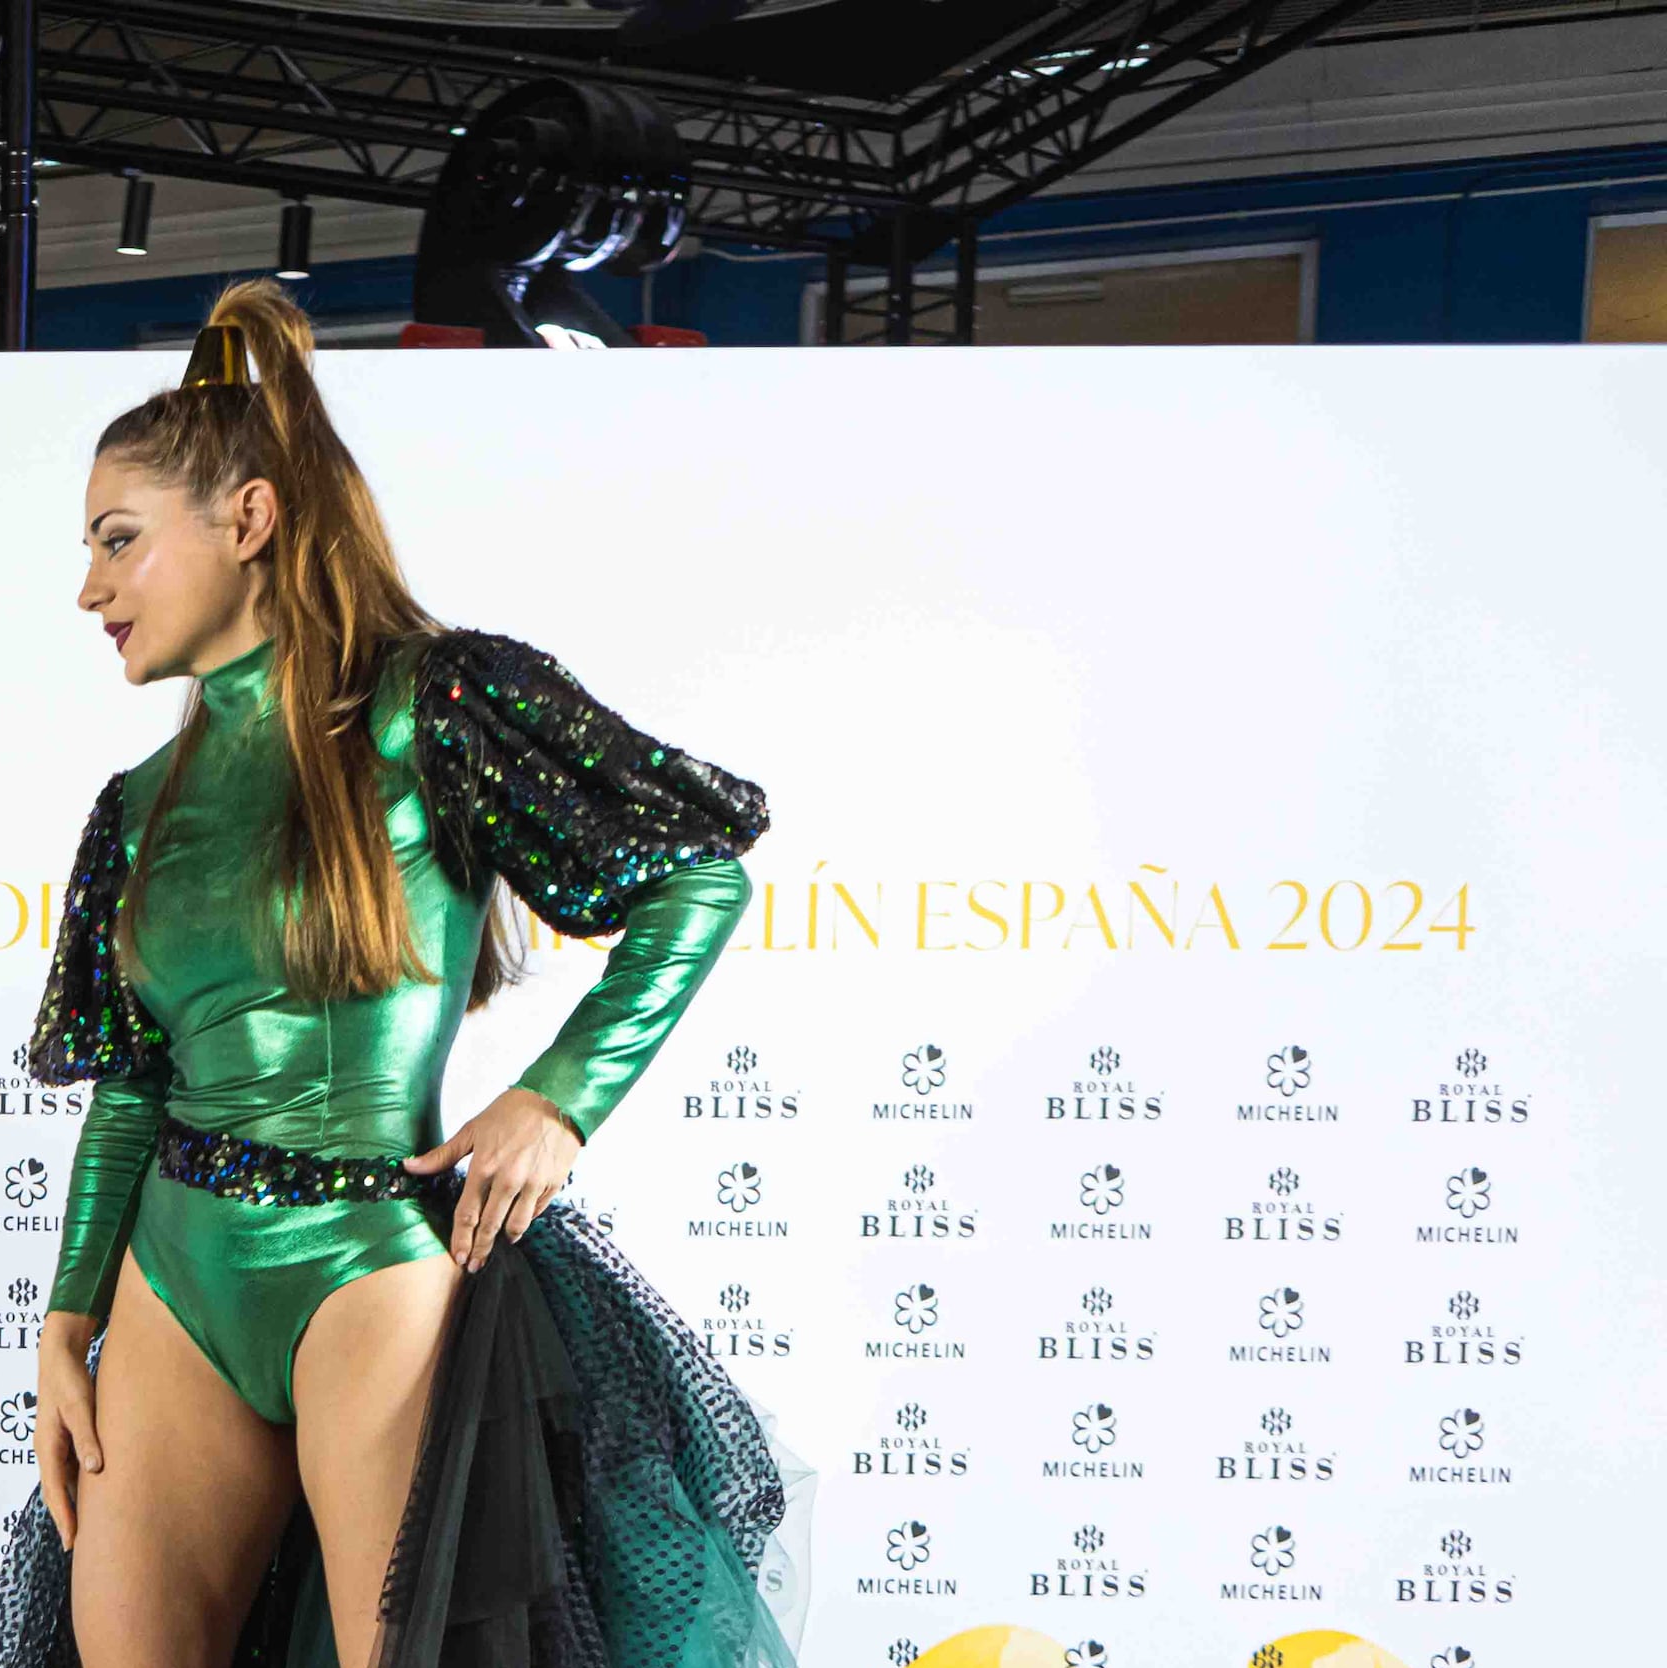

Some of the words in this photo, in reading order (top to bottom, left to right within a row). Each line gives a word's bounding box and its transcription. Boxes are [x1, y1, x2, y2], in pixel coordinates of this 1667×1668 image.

[915, 863, 1241, 951] ESPAÑA
[1266, 880, 1476, 951] 2024
[710, 1080, 771, 1093] ROYAL
[1073, 1081, 1135, 1093] ROYAL
[1440, 1084, 1502, 1096] ROYAL
[683, 1096, 798, 1119] BLISS
[873, 1104, 972, 1120] MICHELIN
[1045, 1097, 1162, 1120] BLISS
[1237, 1104, 1338, 1121] MICHELIN
[1411, 1099, 1528, 1123] BLISS
[887, 1199, 949, 1212] ROYAL
[1252, 1202, 1314, 1214] ROYAL
[689, 1221, 787, 1237] MICHELIN
[860, 1214, 975, 1238] BLISS
[1051, 1223, 1151, 1239] MICHELIN
[1224, 1217, 1341, 1241] BLISS
[1417, 1226, 1518, 1243] MICHELIN
[704, 1318, 764, 1330] ROYAL
[1066, 1322, 1126, 1334] ROYAL
[1432, 1326, 1495, 1338] ROYAL
[705, 1333, 790, 1357] LISS
[866, 1342, 965, 1358] MICHELIN
[1038, 1336, 1154, 1360] BLISS
[1404, 1341, 1521, 1365] BLISS
[1230, 1346, 1330, 1362] MICHELIN
[880, 1437, 941, 1449] ROYAL
[1245, 1441, 1306, 1454] ROYAL
[852, 1452, 967, 1476] BLISS
[1043, 1461, 1143, 1478] MICHELIN
[1216, 1456, 1333, 1481] BLISS
[1409, 1466, 1511, 1483] MICHELIN
[1057, 1559, 1119, 1571] ROYAL
[1423, 1564, 1486, 1576] ROYAL
[857, 1578, 957, 1595] MICHELIN
[1030, 1573, 1145, 1597] BLISS
[1221, 1584, 1322, 1600] MICHELIN
[1396, 1579, 1512, 1603] BLISS
